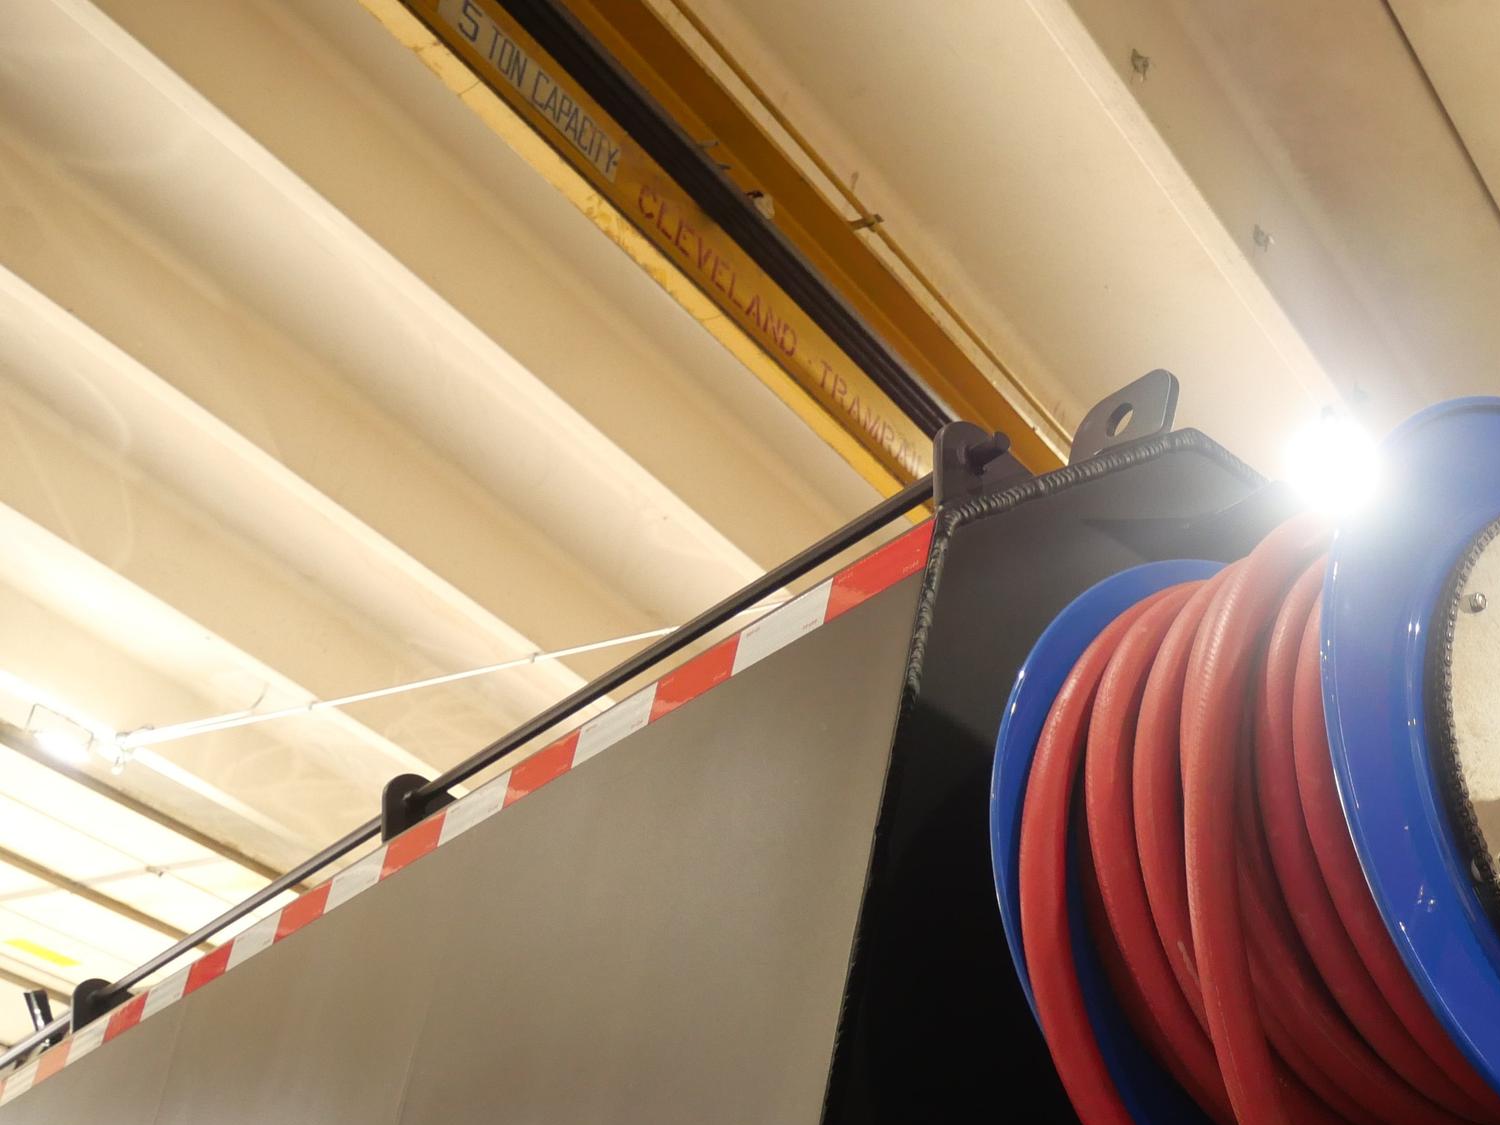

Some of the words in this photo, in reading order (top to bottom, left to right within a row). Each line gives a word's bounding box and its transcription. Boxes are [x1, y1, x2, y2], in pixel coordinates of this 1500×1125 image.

[457, 1, 486, 43] 5
[488, 22, 528, 89] TON
[530, 71, 619, 174] CAPACITY
[637, 183, 798, 357] CLEVELAND
